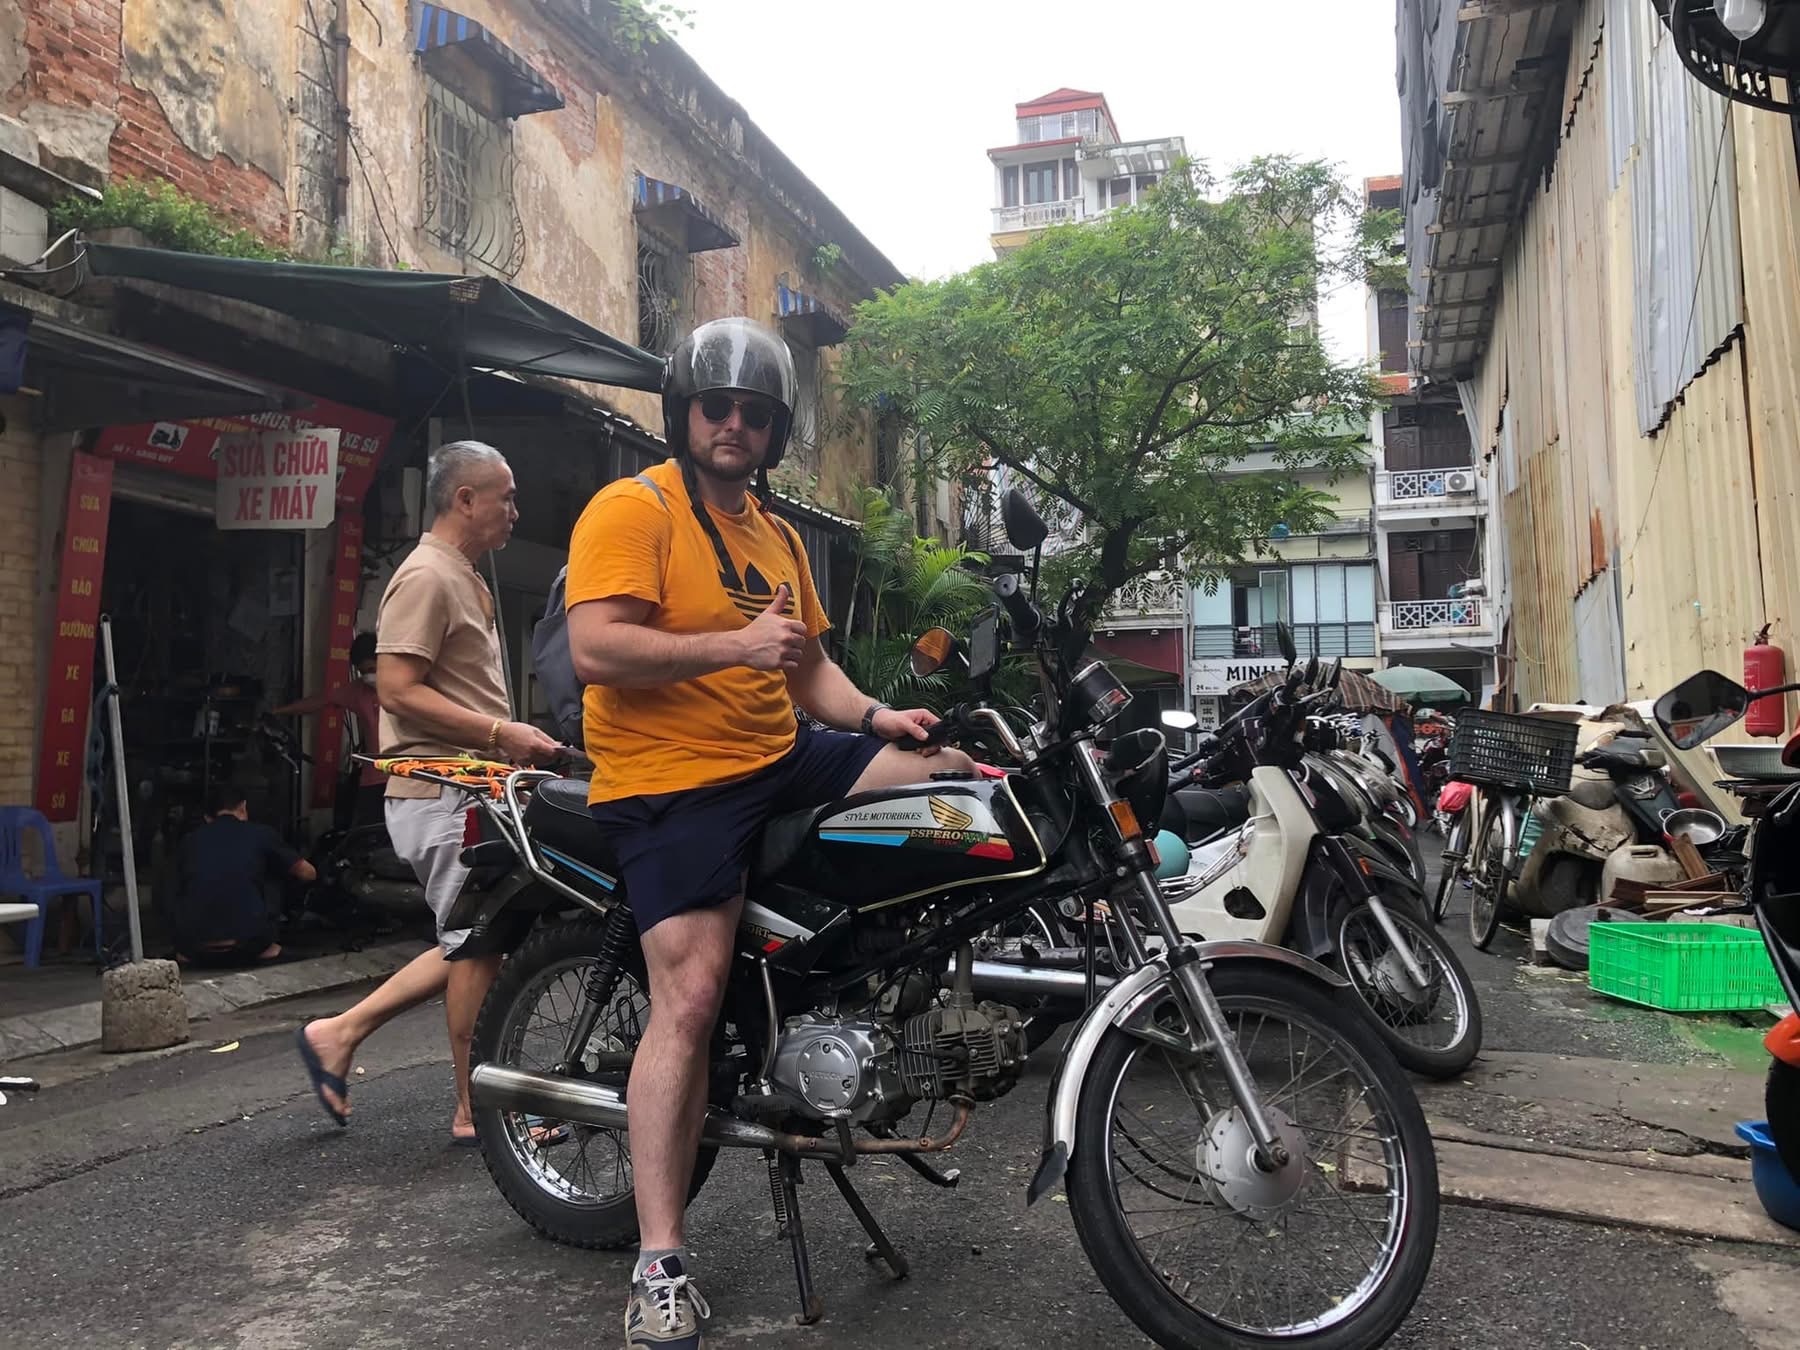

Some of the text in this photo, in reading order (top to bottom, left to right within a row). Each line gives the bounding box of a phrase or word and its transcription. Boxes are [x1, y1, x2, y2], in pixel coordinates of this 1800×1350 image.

[272, 434, 329, 477] CHỮA
[236, 479, 318, 521] XE MÁY
[65, 664, 80, 681] XE
[844, 811, 923, 822] STYLE MOTORBIKES
